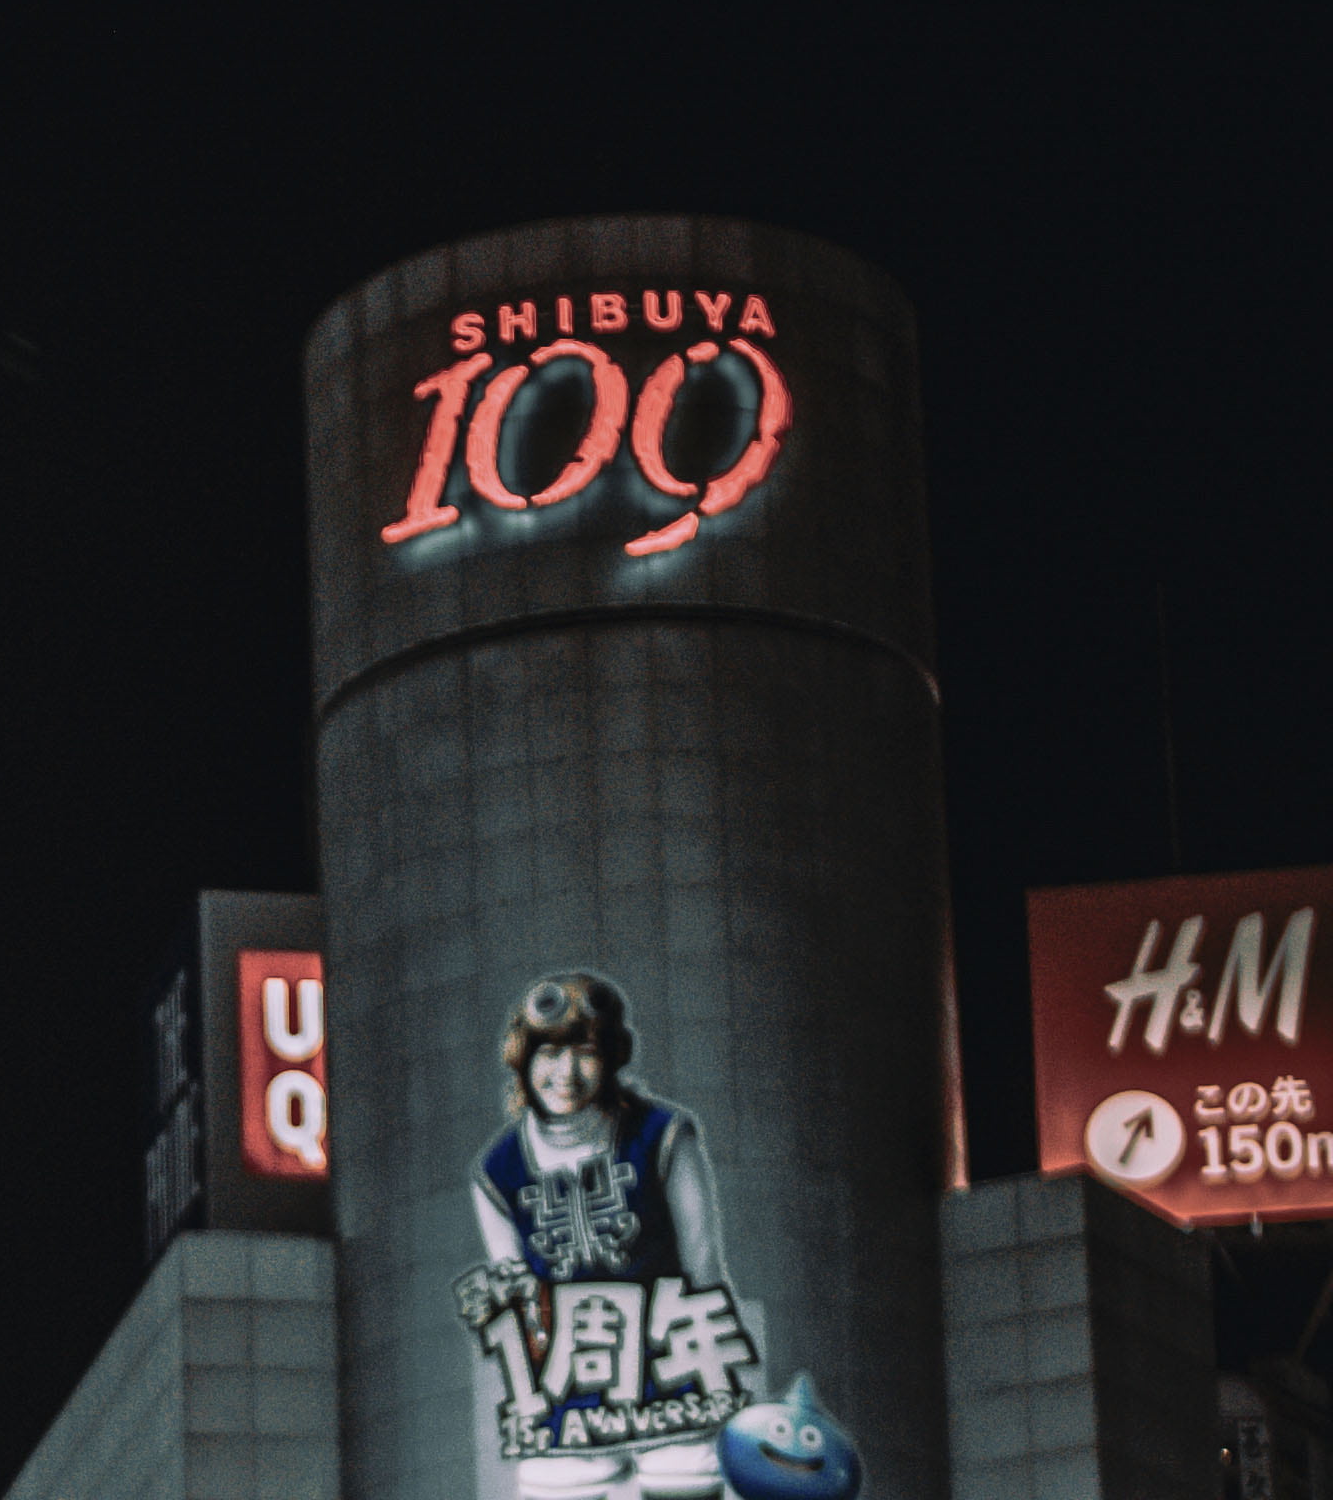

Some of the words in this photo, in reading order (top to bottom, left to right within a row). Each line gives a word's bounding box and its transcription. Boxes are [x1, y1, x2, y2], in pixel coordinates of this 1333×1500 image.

[450, 290, 776, 352] SHIBUYA
[381, 338, 793, 557] 109
[1104, 906, 1315, 1056] H&M
[1194, 1075, 1315, 1121] この先
[485, 1276, 758, 1418] 1周年
